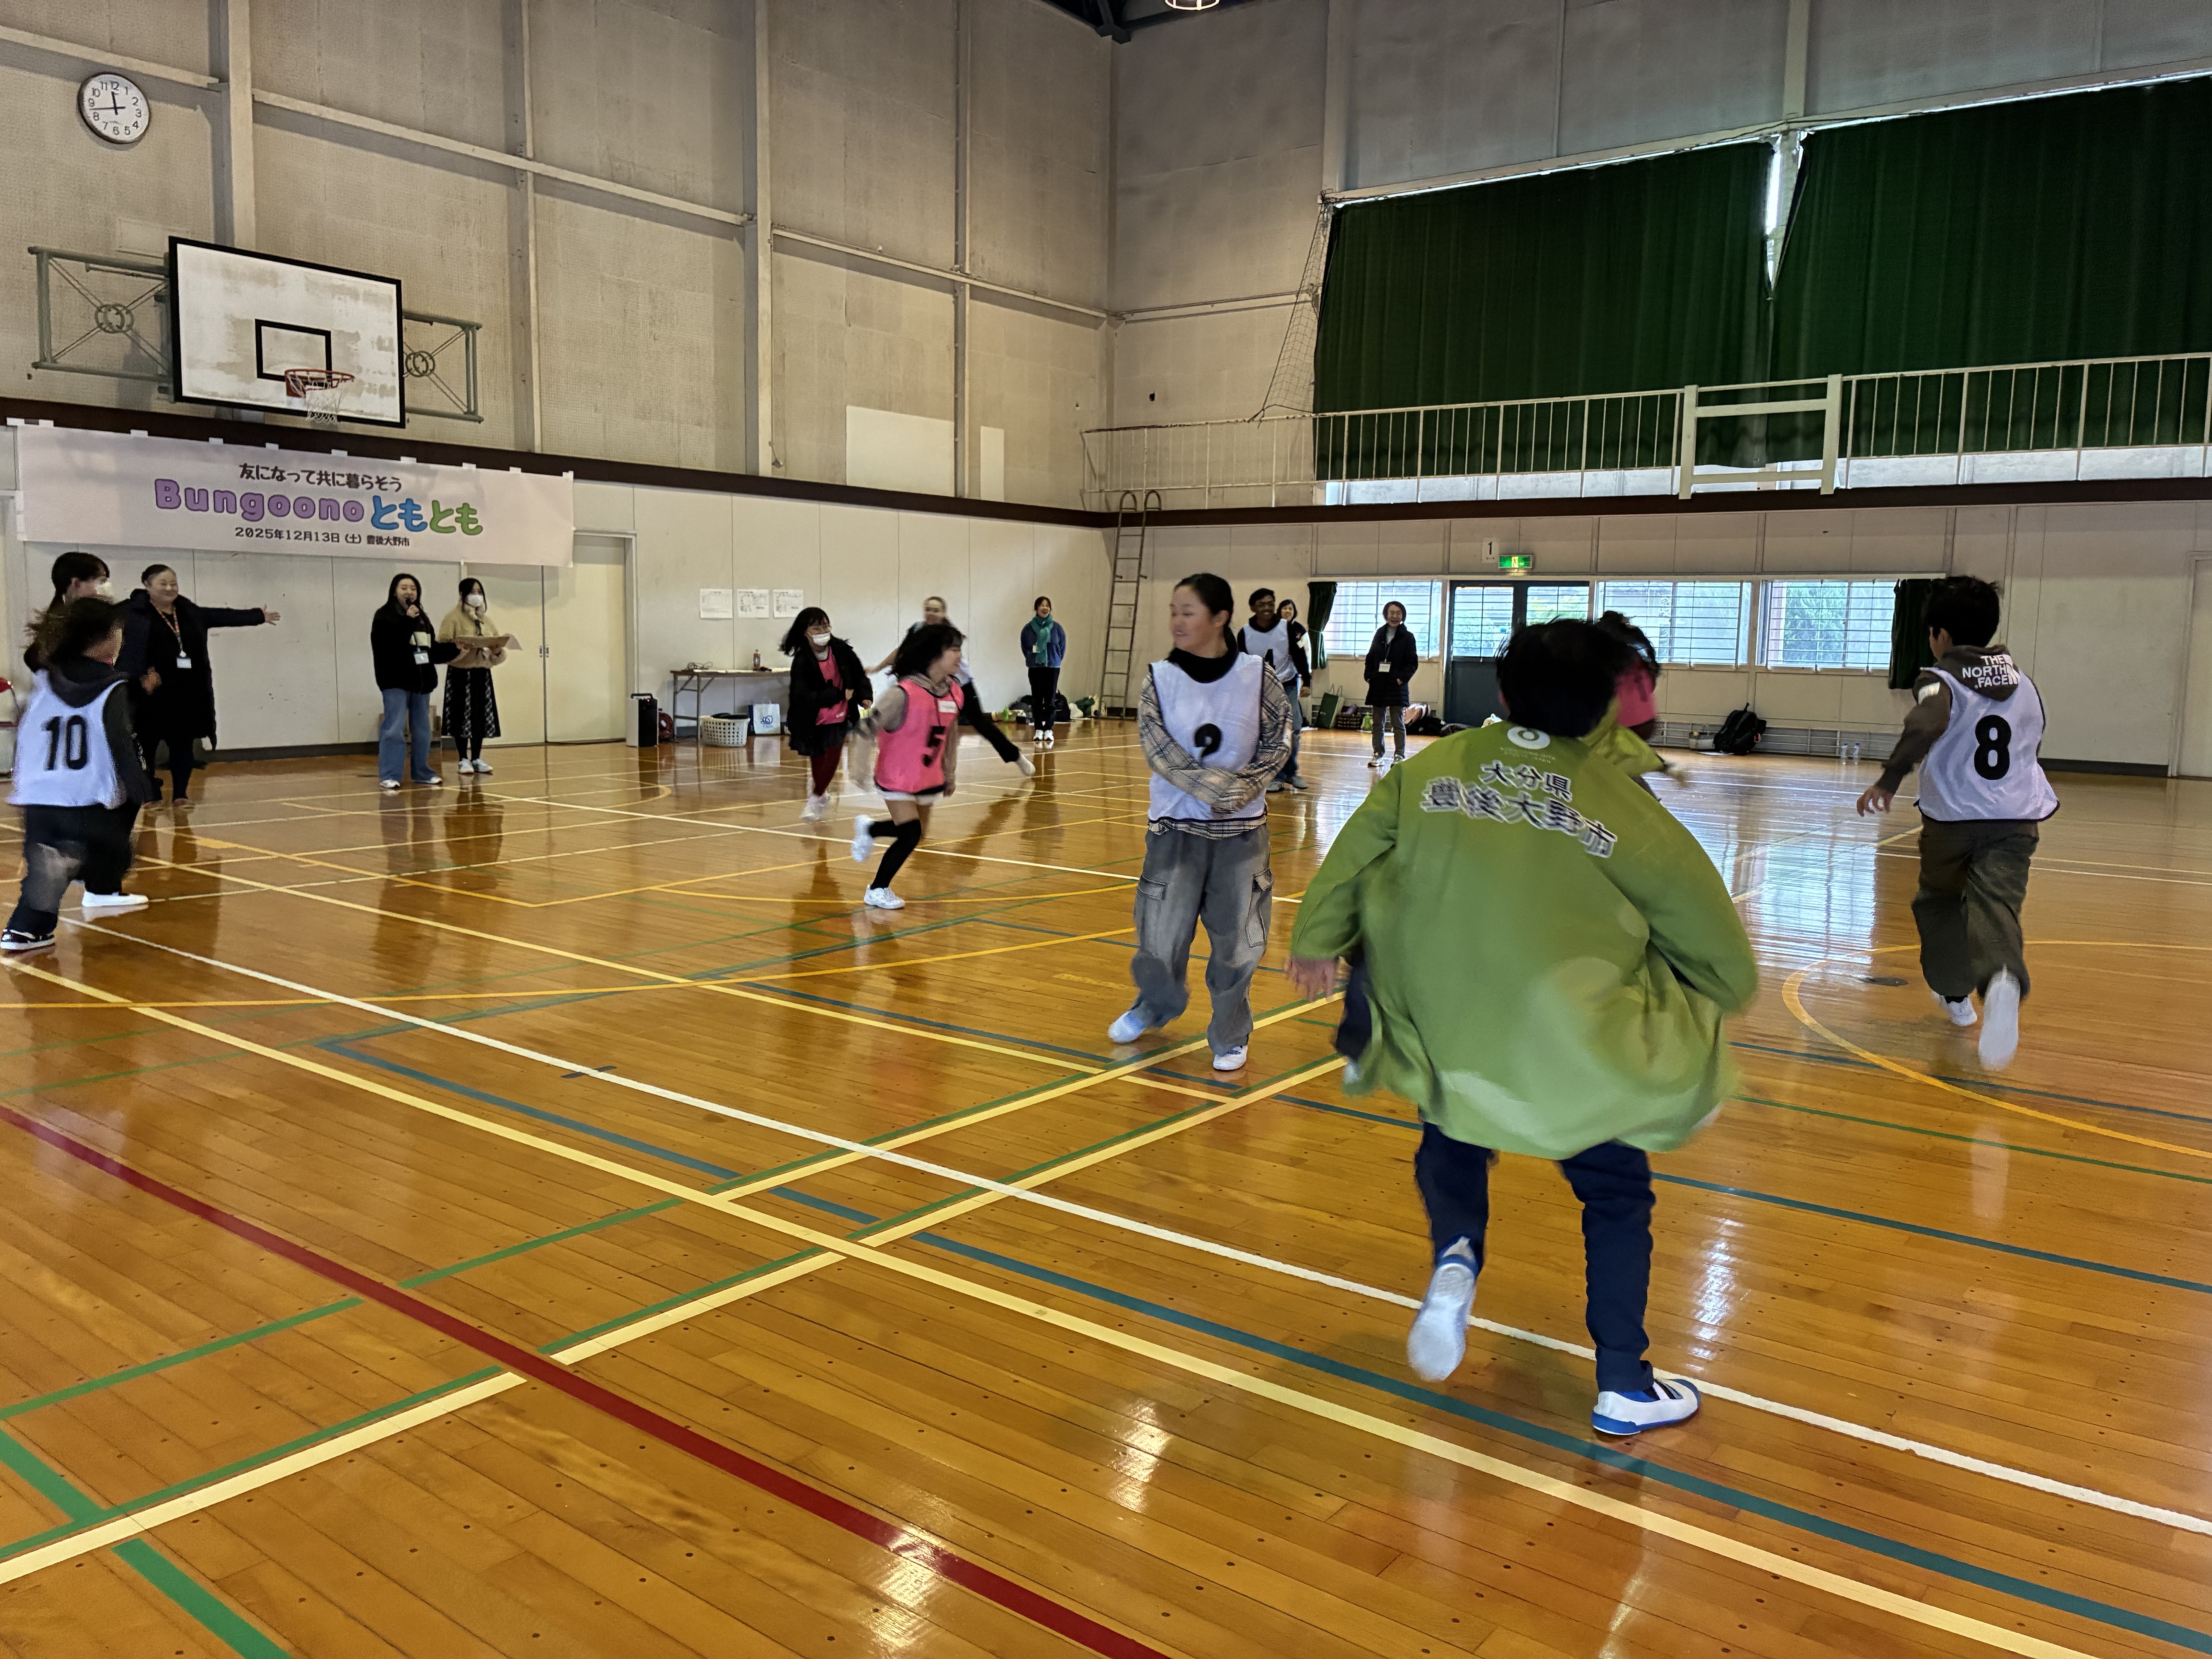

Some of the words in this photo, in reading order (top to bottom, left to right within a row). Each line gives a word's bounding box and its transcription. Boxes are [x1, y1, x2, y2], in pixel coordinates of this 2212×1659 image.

[100, 81, 107, 90] 11
[110, 81, 119, 90] 12
[92, 88, 100, 97] 10
[125, 86, 128, 95] 1
[88, 98, 94, 107] 9
[132, 97, 138, 106] 2
[93, 112, 99, 121] 8
[136, 108, 141, 117] 3
[103, 121, 108, 130] 7
[132, 121, 139, 129] 4
[113, 126, 119, 135] 6
[125, 126, 130, 135] 5
[239, 463, 402, 492] 友になって共に暮らそう
[1488, 541, 1492, 555] 1
[1981, 655, 2005, 665] THE
[1962, 664, 2006, 678] NORTH
[1977, 675, 2008, 688] FACE
[42, 715, 88, 771] 10
[922, 726, 946, 768] 5
[1974, 714, 2011, 780] 8
[1478, 759, 1573, 802] 大分県
